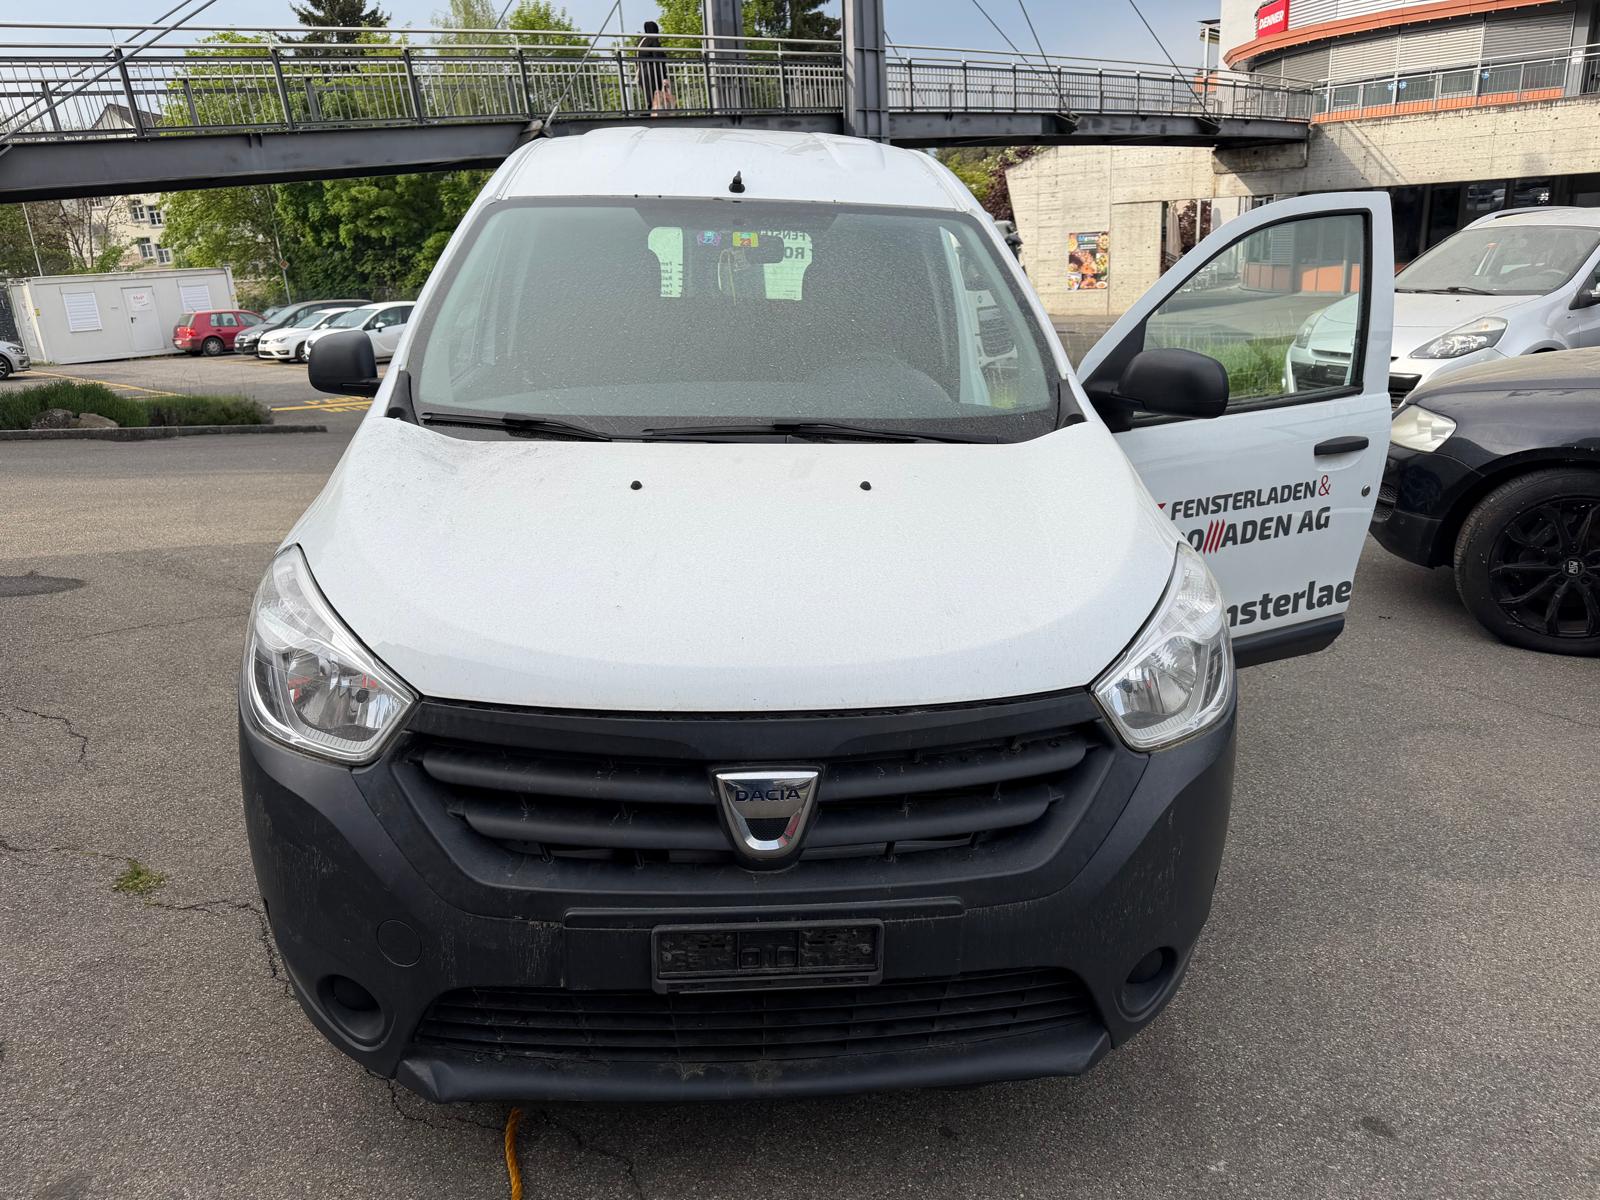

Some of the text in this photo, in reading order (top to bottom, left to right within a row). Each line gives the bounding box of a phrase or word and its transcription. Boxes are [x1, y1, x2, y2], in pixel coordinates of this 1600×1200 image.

[1258, 10, 1284, 30] DENNER
[1297, 506, 1331, 534] AG
[735, 788, 801, 802] DACIA
